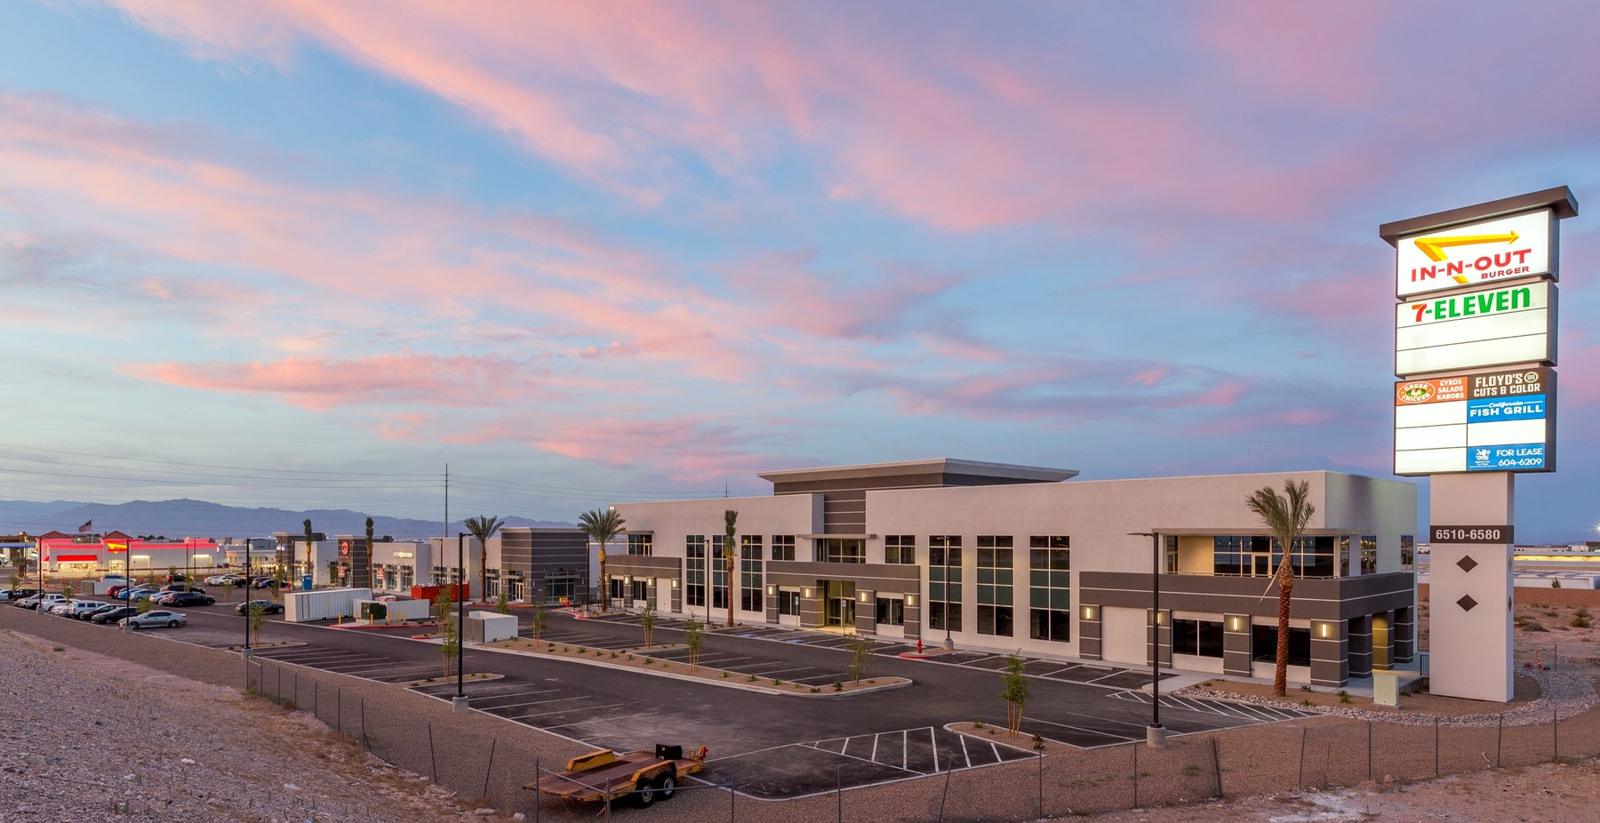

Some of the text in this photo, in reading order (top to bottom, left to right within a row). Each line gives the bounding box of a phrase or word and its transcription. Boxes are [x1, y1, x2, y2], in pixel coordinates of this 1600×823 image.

[1411, 248, 1531, 282] IN-N-OUT
[1481, 266, 1529, 279] BURGER
[1475, 373, 1523, 388] FLOYD'S
[1437, 386, 1463, 394] SALADS
[1473, 383, 1541, 397] CUTS & COLOR
[1470, 405, 1543, 418] FISH GRILL
[1496, 448, 1543, 457] FOR LEASE
[1498, 458, 1542, 467] 604-6209
[1435, 529, 1501, 540] 6510-6580
